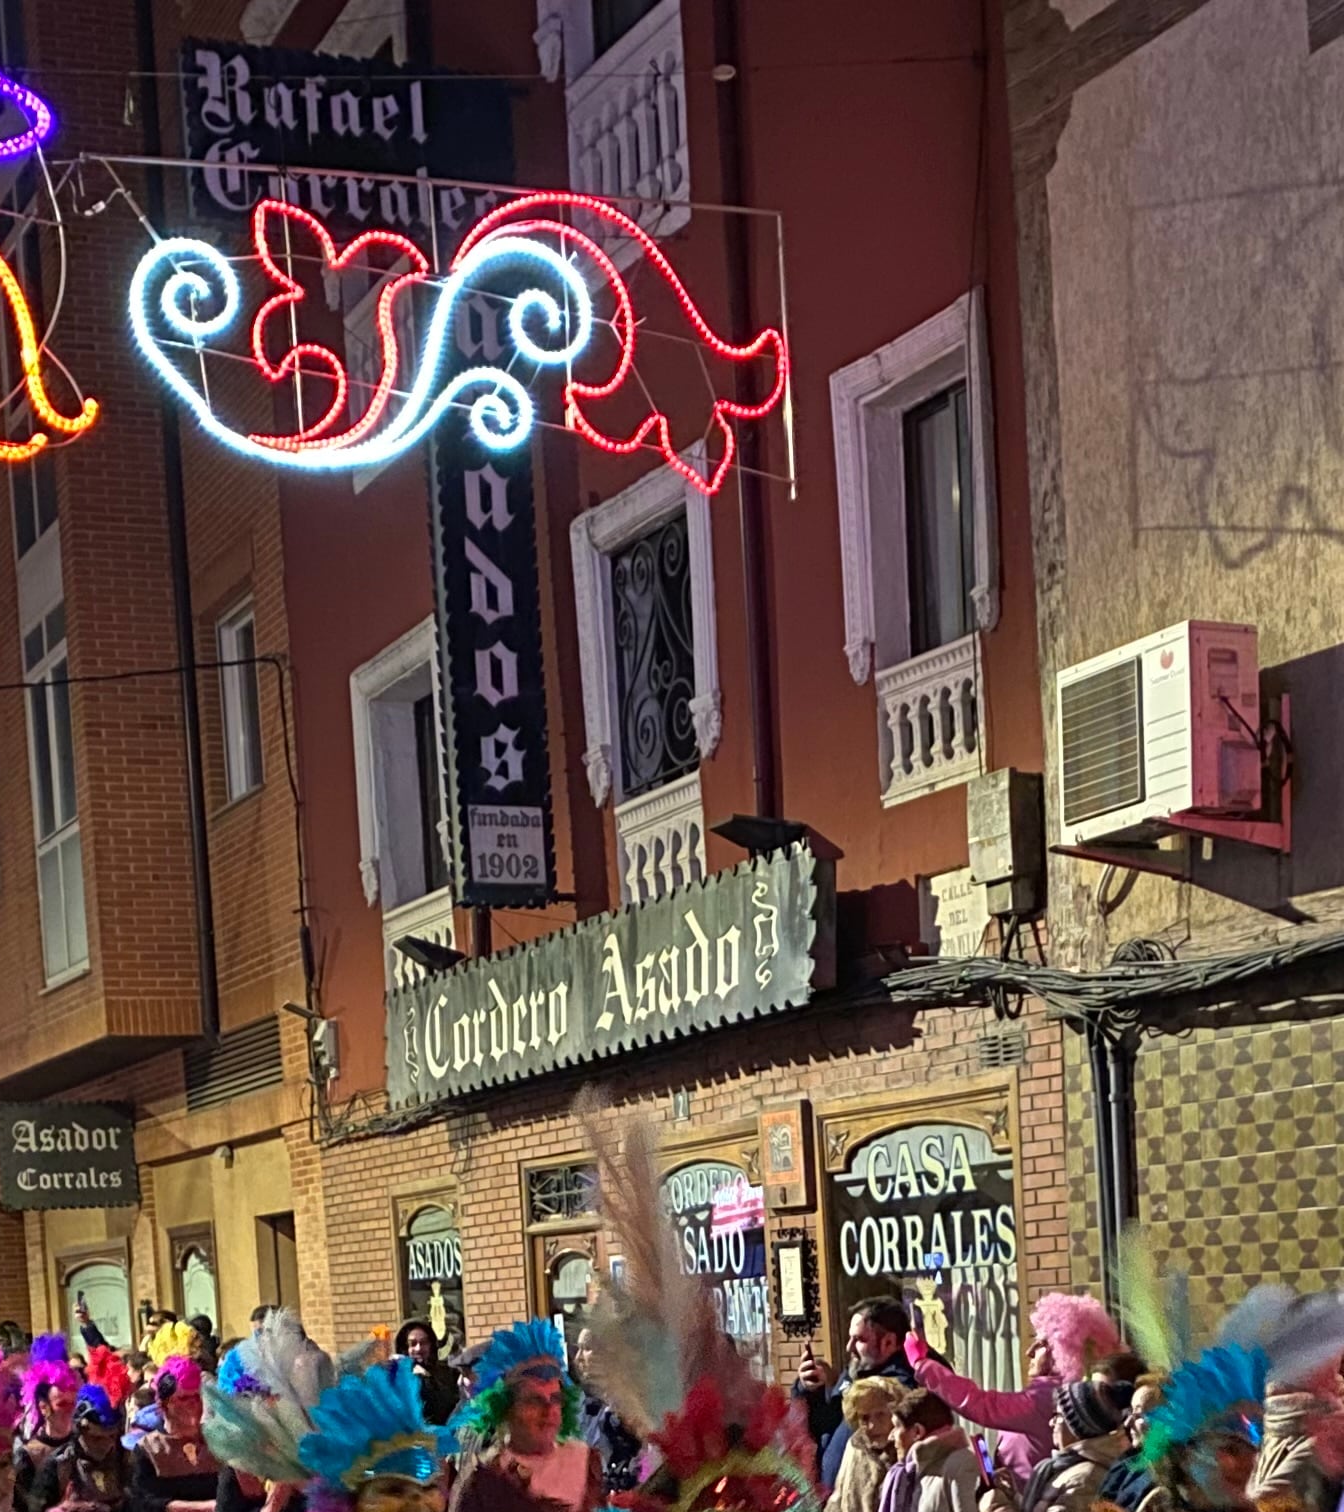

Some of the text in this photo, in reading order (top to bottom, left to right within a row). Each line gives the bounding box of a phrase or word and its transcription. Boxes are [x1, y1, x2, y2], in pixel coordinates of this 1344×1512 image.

[196, 49, 428, 145] Rafael
[469, 806, 542, 829] fundada
[496, 832, 519, 849] en
[477, 853, 540, 879] 1902
[424, 908, 743, 1080] Cordero Asado
[11, 1119, 122, 1154] Asador
[16, 1166, 123, 1192] Corrales
[866, 1132, 977, 1203] CASA
[408, 1236, 463, 1281] ASADOS
[839, 1204, 1017, 1277] CORRALES
